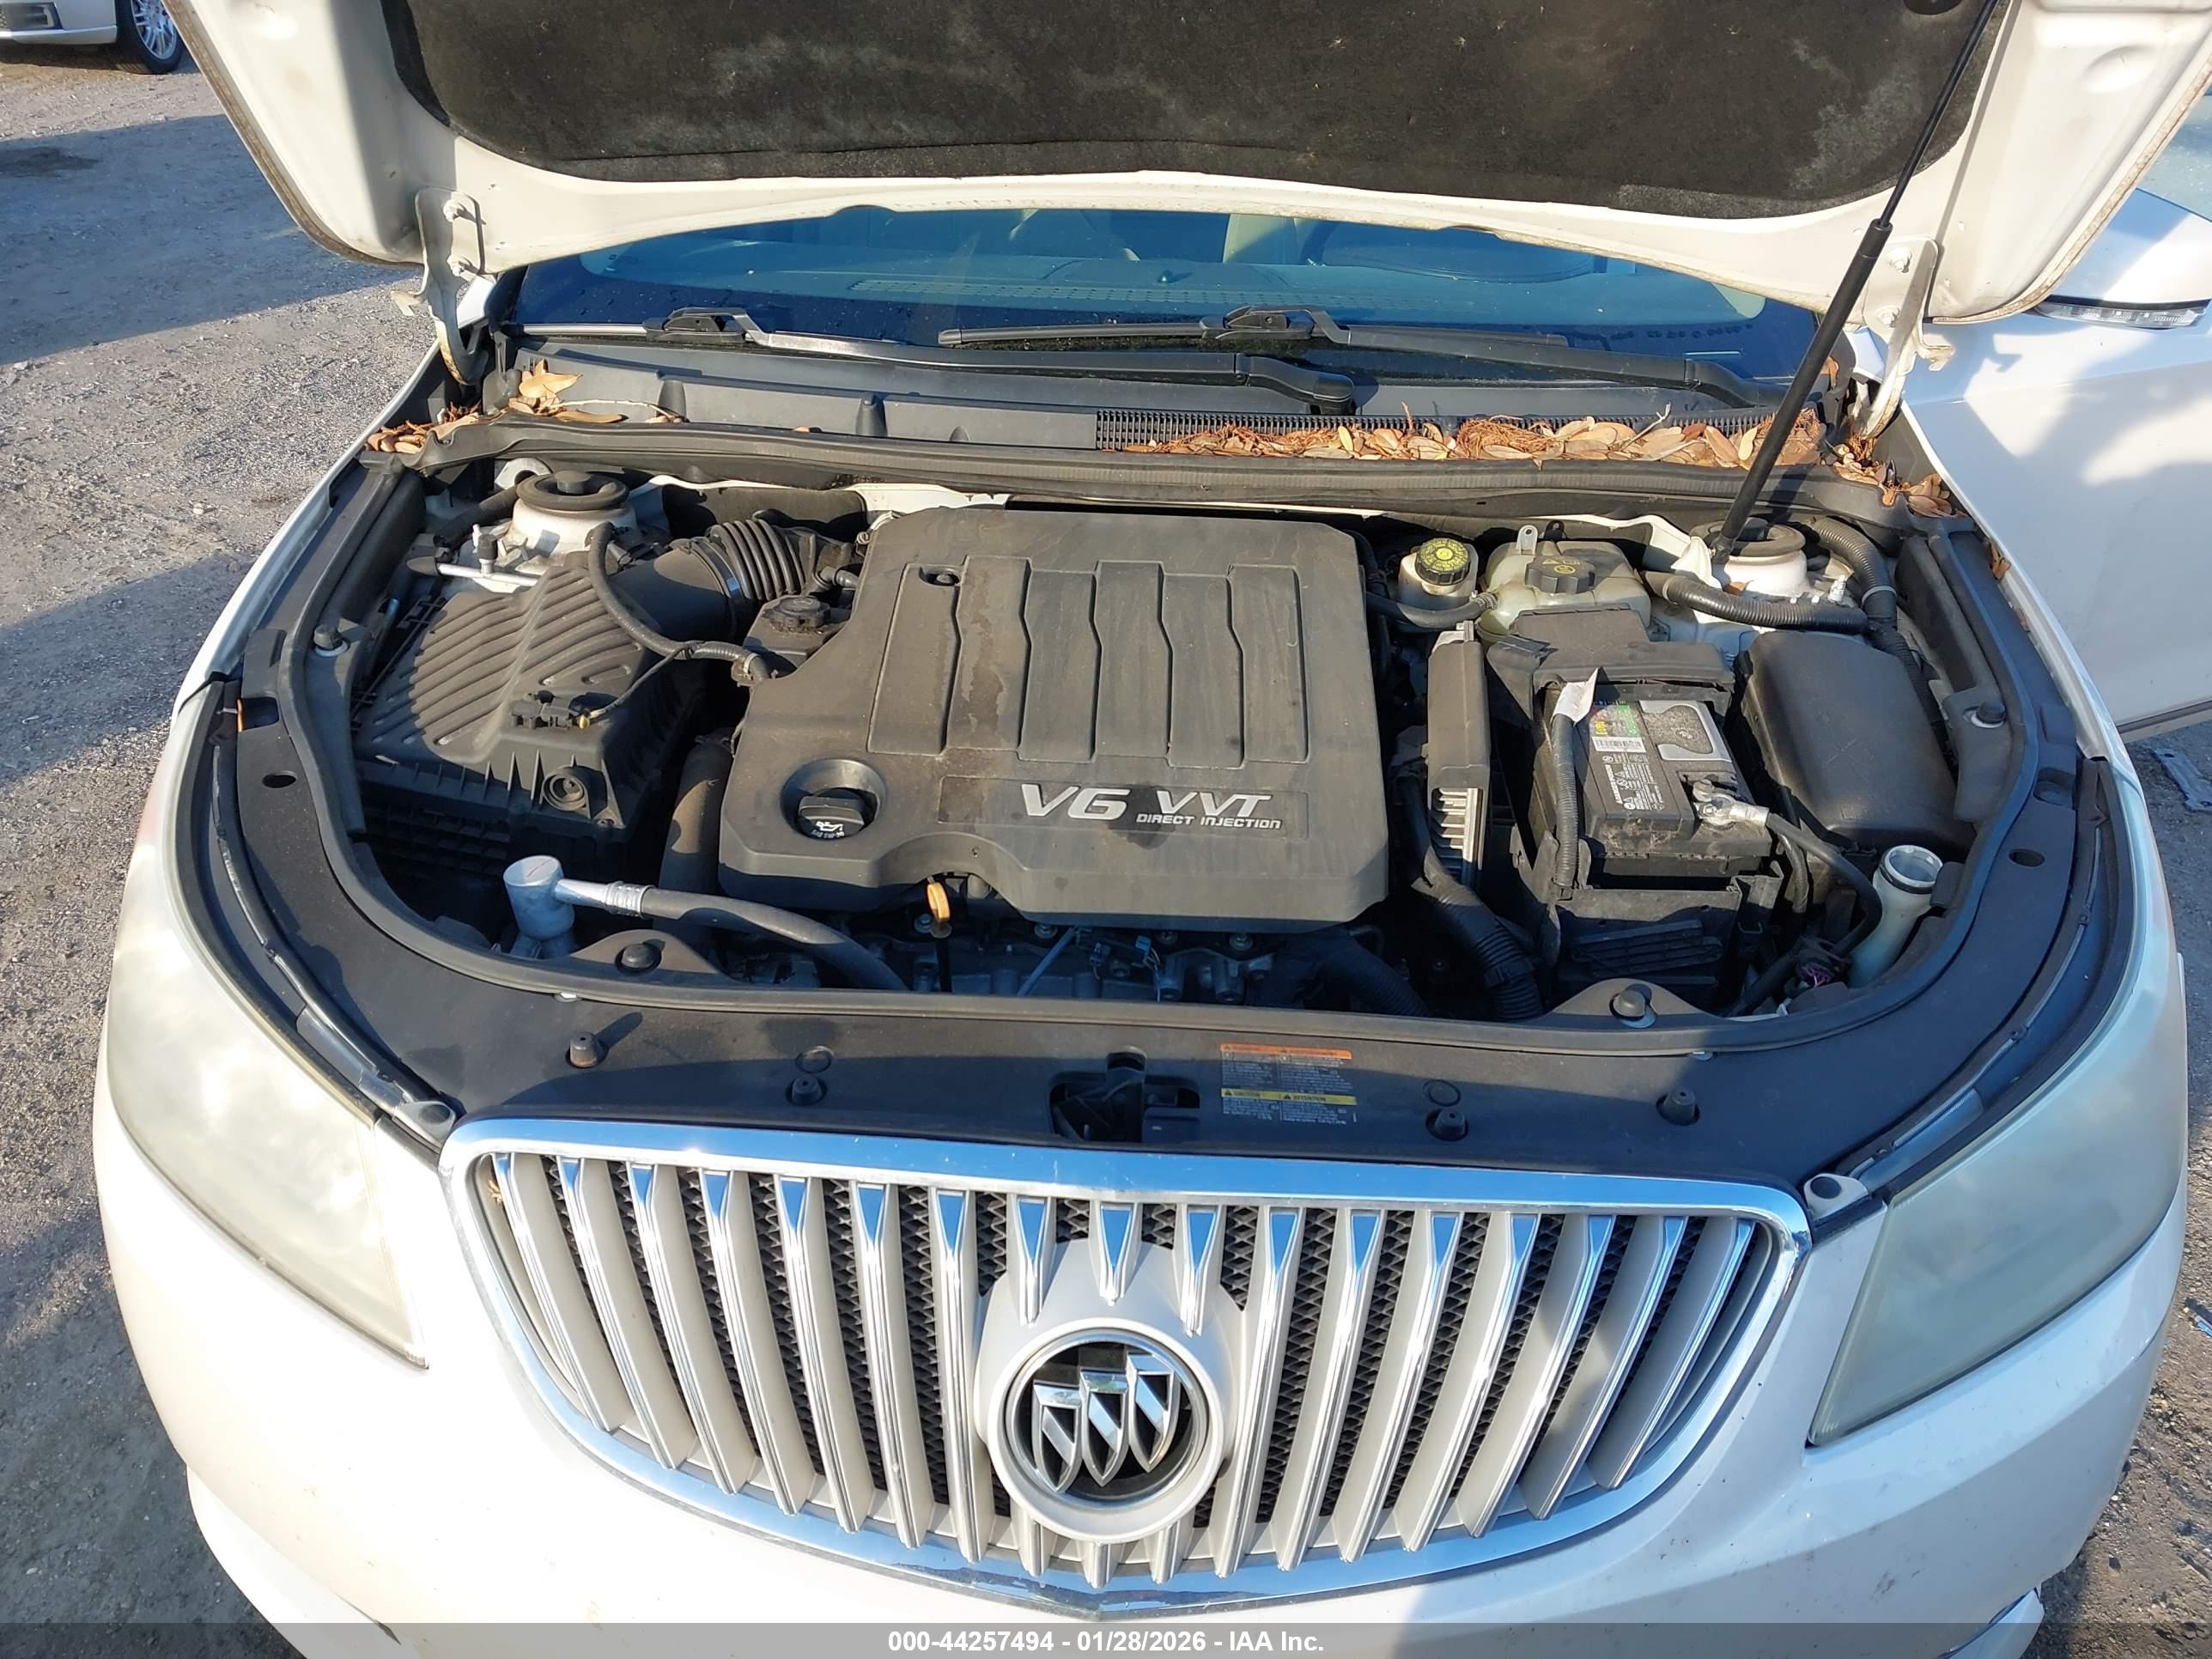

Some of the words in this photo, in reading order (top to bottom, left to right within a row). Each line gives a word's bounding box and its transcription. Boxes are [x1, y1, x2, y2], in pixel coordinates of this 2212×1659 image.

[1021, 783, 1132, 820] V6
[1157, 790, 1273, 817] VVT
[1135, 813, 1195, 825] DIRECT
[1200, 816, 1282, 830] INJECTION
